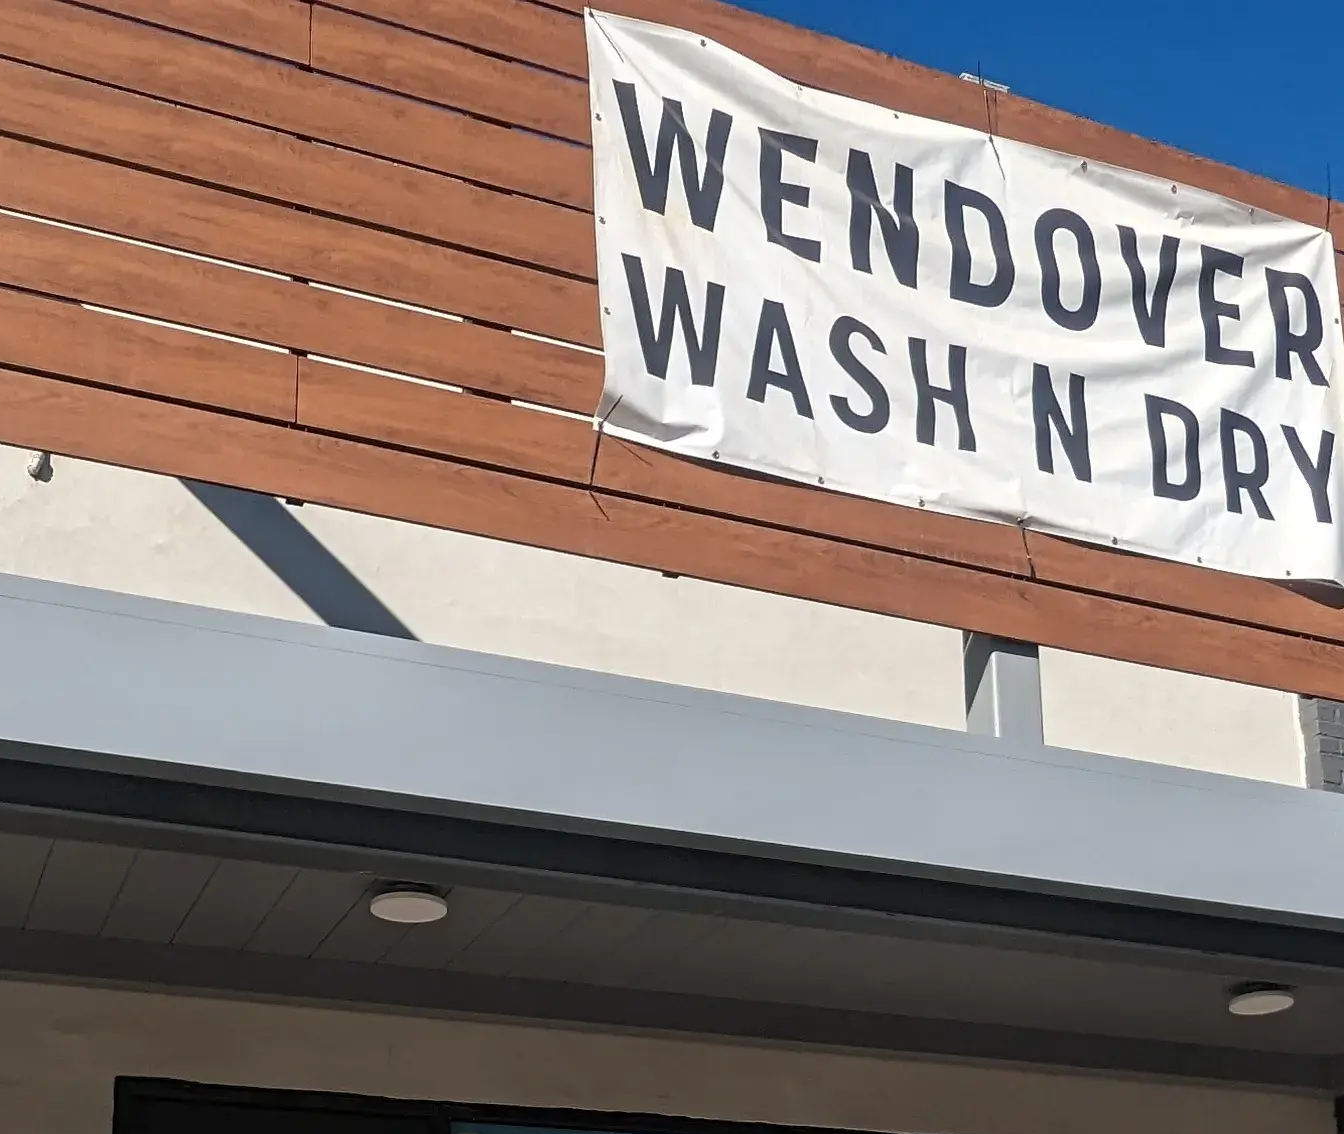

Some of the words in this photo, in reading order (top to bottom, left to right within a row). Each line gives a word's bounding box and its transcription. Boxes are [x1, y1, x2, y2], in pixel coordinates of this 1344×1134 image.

[612, 79, 1330, 387] WENDOVER
[621, 252, 977, 453] WASH
[1031, 363, 1092, 483] N
[1144, 394, 1335, 524] DRY
